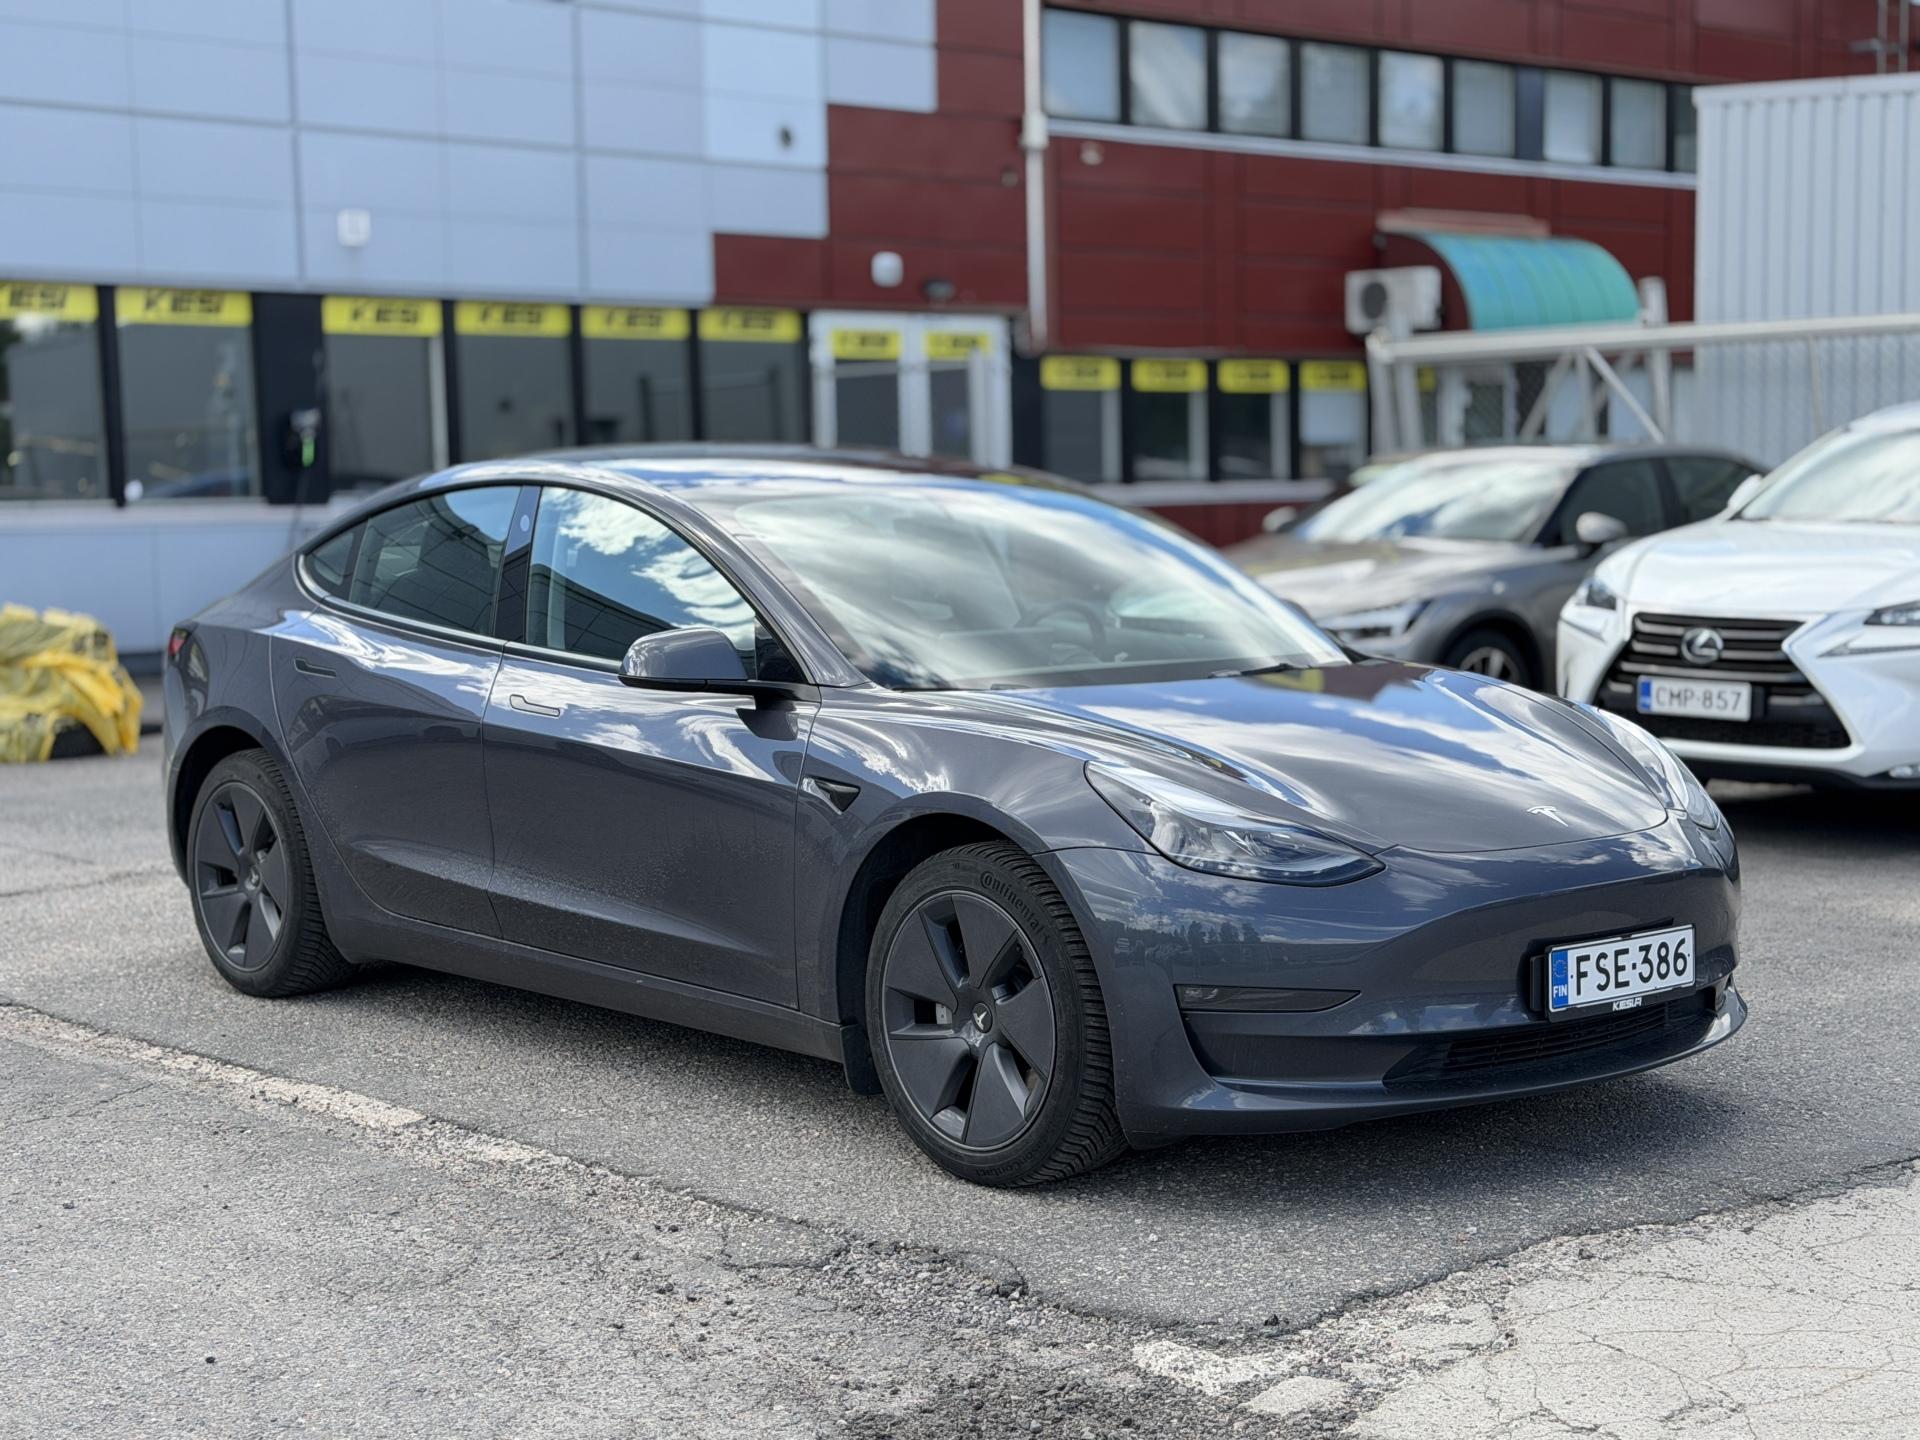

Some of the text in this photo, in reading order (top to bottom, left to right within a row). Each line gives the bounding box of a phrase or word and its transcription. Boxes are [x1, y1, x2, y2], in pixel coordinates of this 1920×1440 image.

[1655, 686, 1742, 712] CMP-857
[980, 870, 1046, 936] Continental
[1575, 937, 1688, 996] FSE-386
[1553, 984, 1568, 998] FIN
